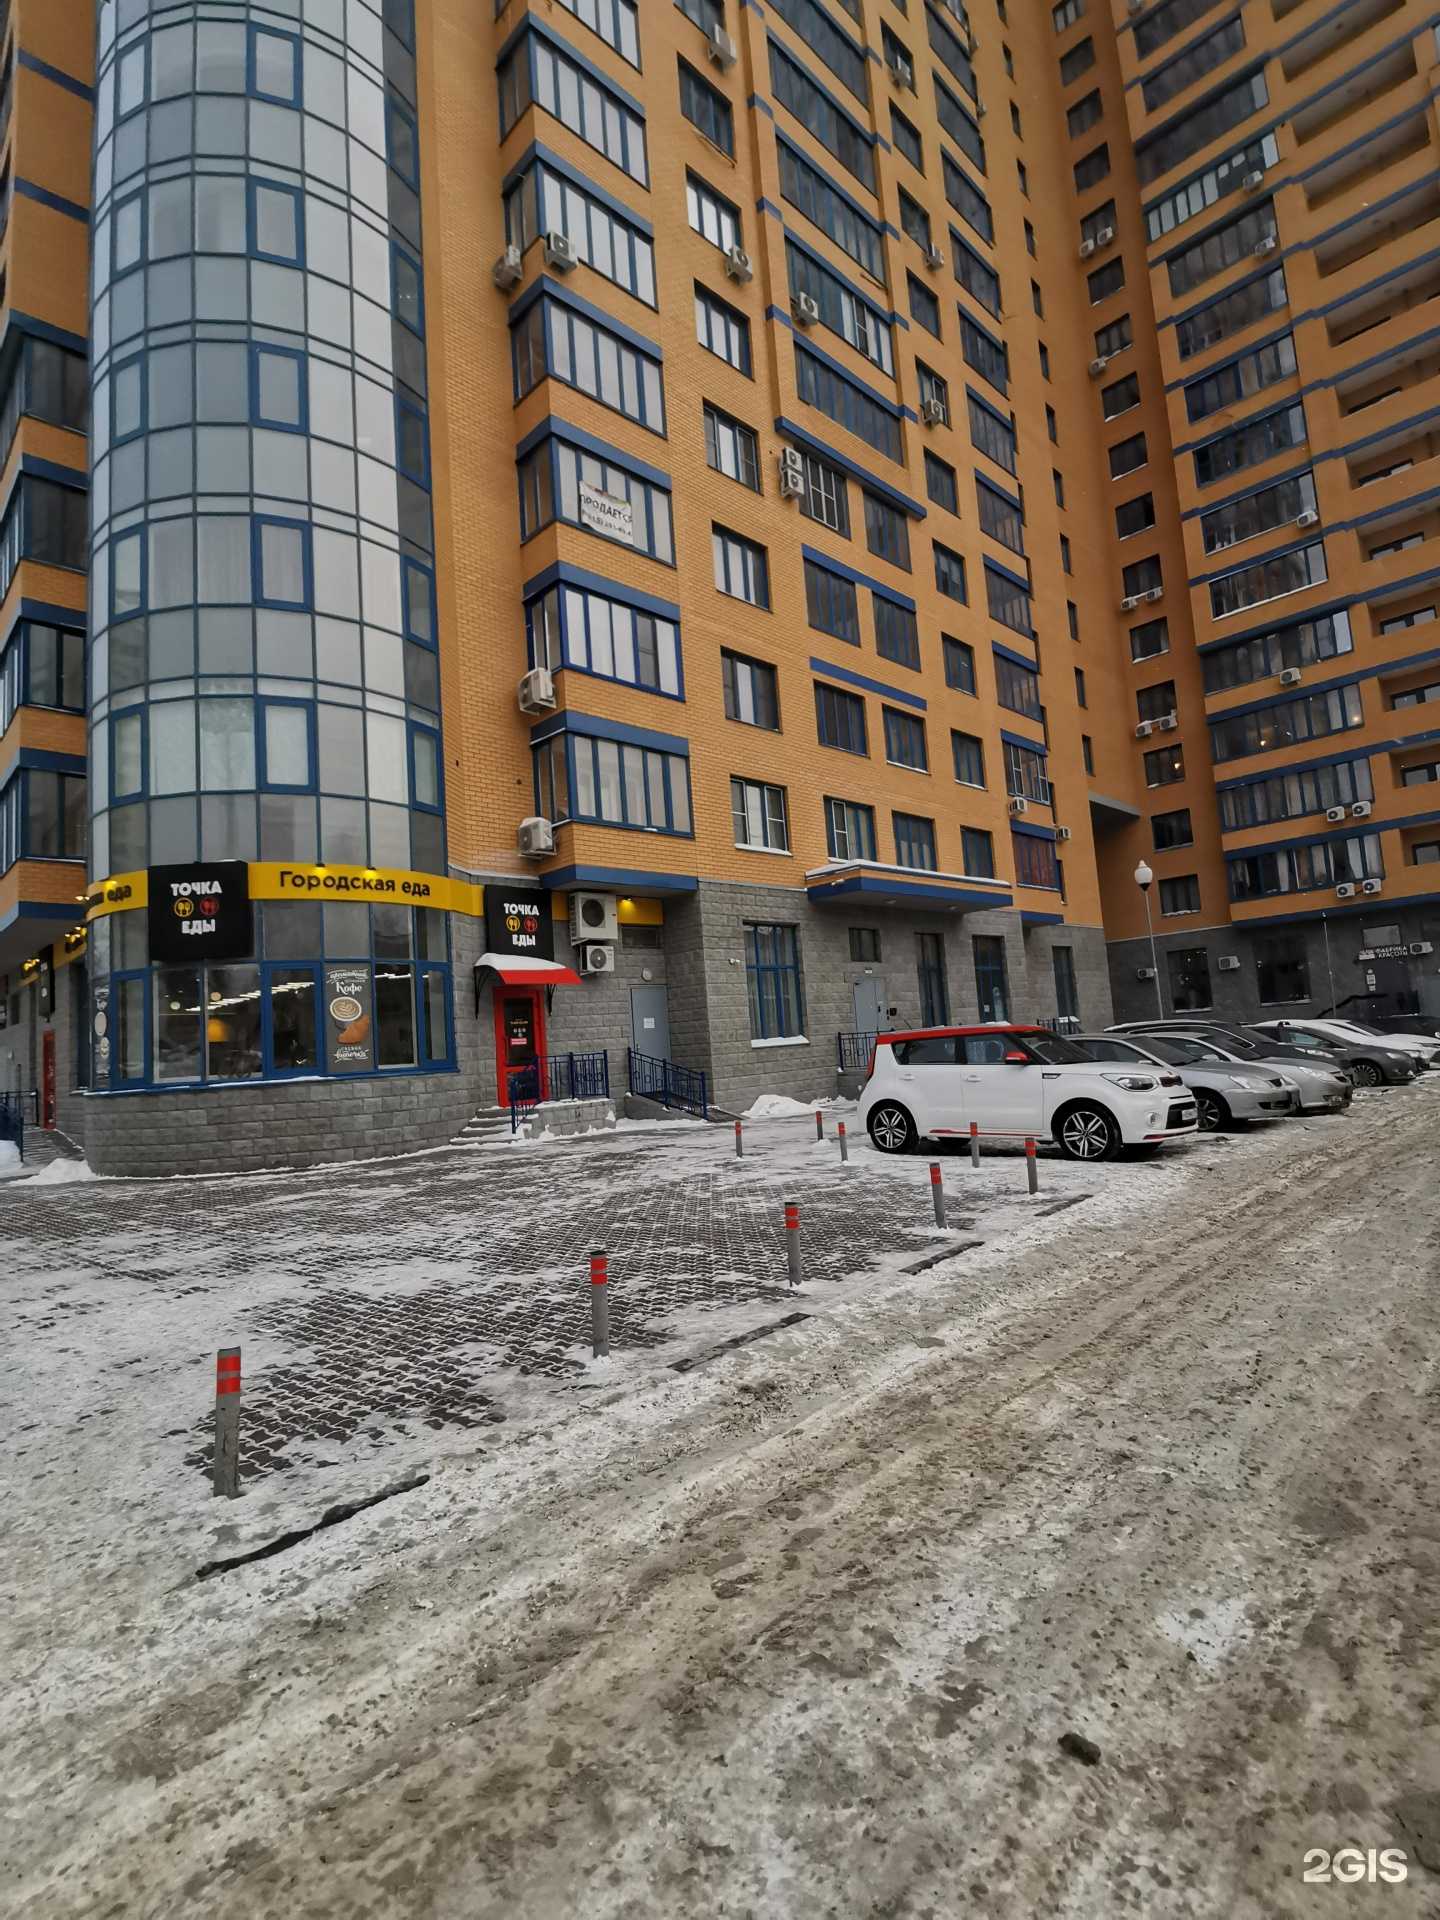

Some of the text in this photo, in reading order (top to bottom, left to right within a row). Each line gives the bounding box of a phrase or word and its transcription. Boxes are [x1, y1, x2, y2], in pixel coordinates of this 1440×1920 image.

[170, 880, 223, 897] ТОЧКА
[280, 871, 431, 897] Городская еда
[107, 885, 132, 902] еда
[503, 902, 540, 916] ТОЧКА
[181, 919, 216, 935] ЕДЫ
[512, 934, 536, 948] ЕДЫ
[336, 981, 362, 996] Кофе
